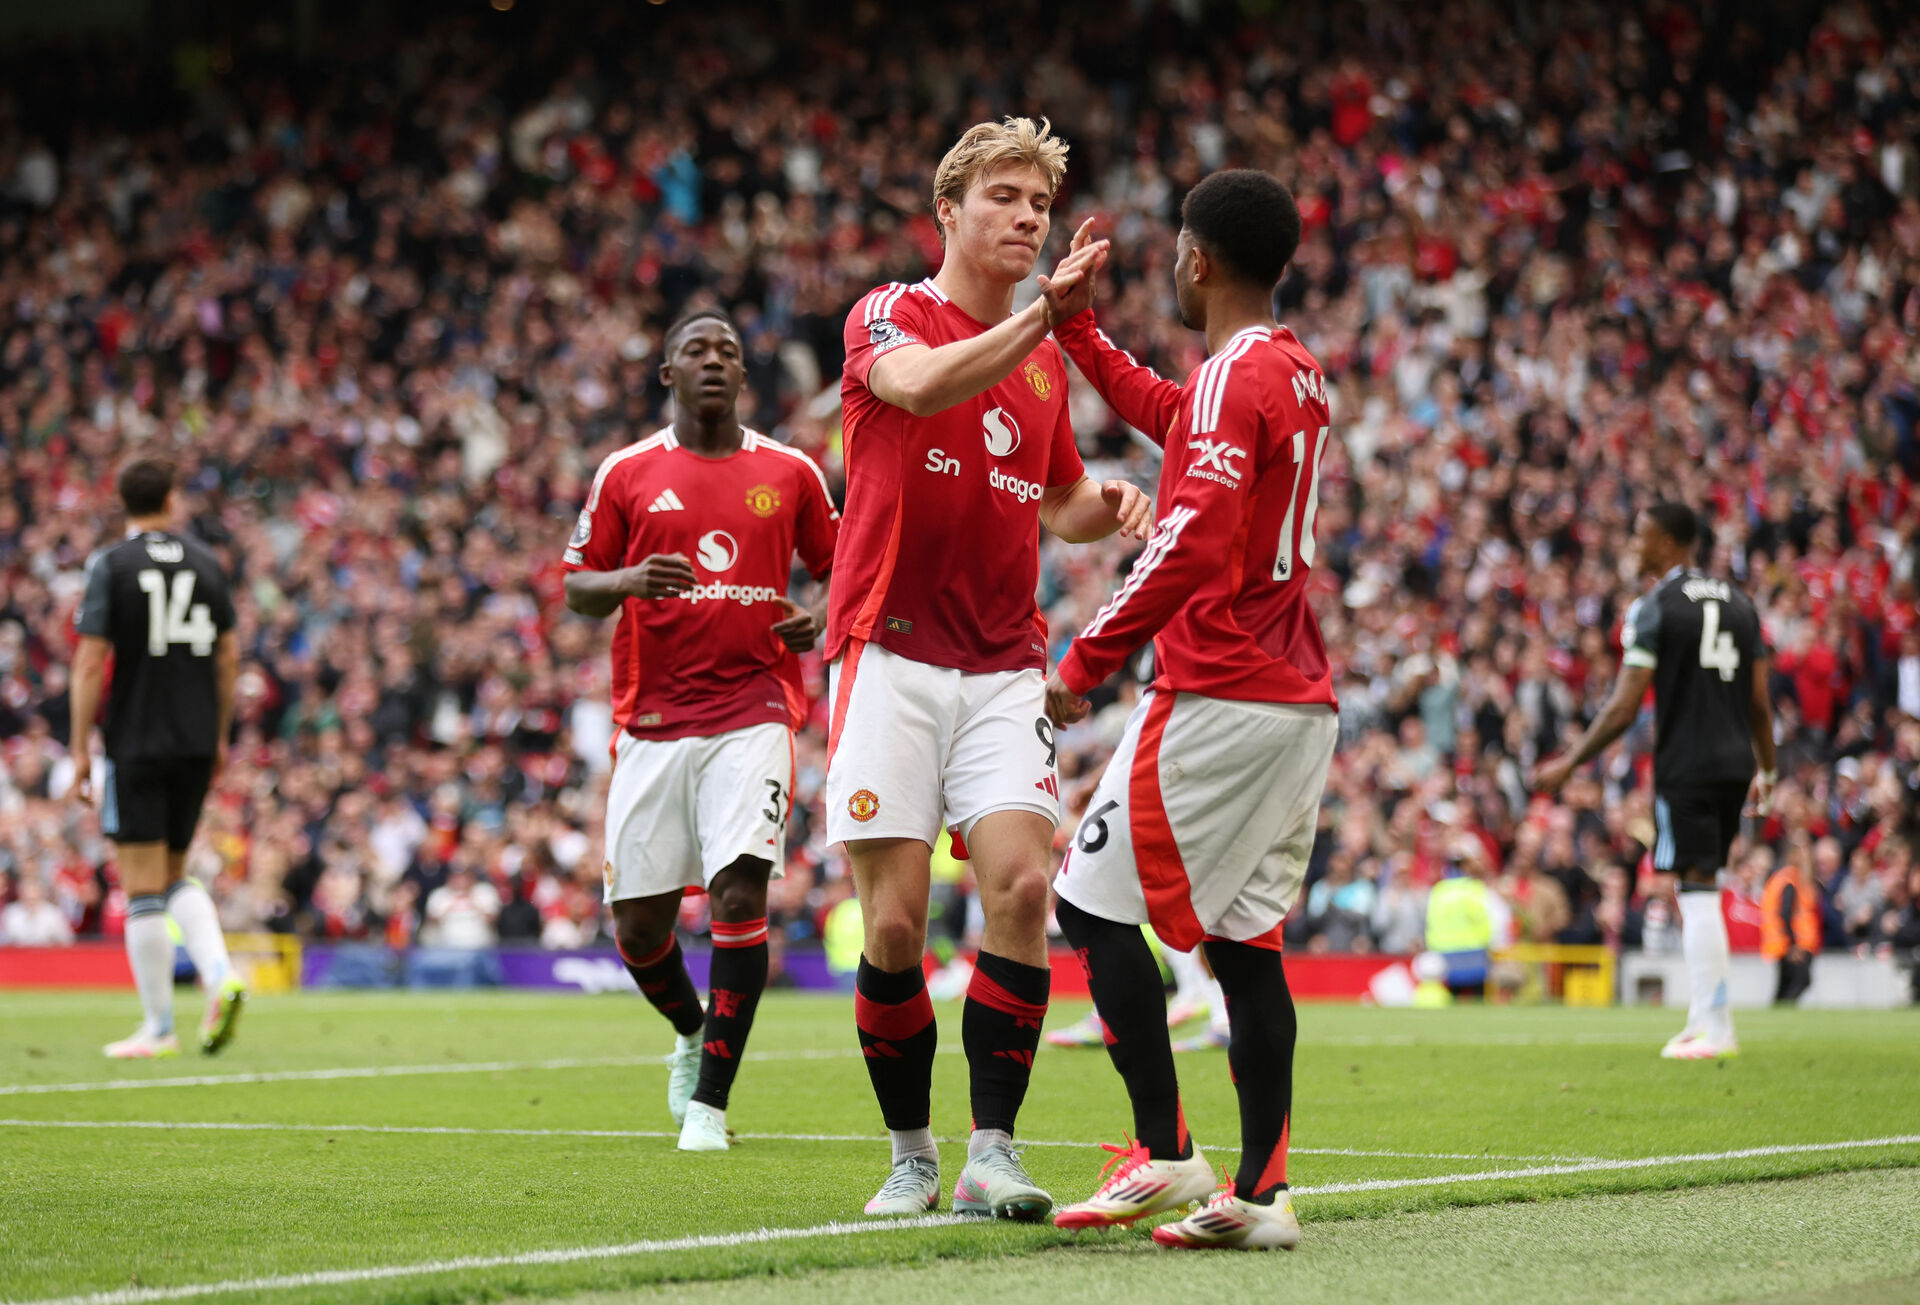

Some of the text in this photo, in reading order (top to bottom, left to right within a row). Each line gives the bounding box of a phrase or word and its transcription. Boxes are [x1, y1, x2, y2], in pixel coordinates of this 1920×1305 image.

[989, 466, 1045, 504] drago
[137, 568, 218, 658] 14
[1699, 600, 1740, 682] 4
[1035, 717, 1056, 768] 9
[763, 779, 790, 832] 3
